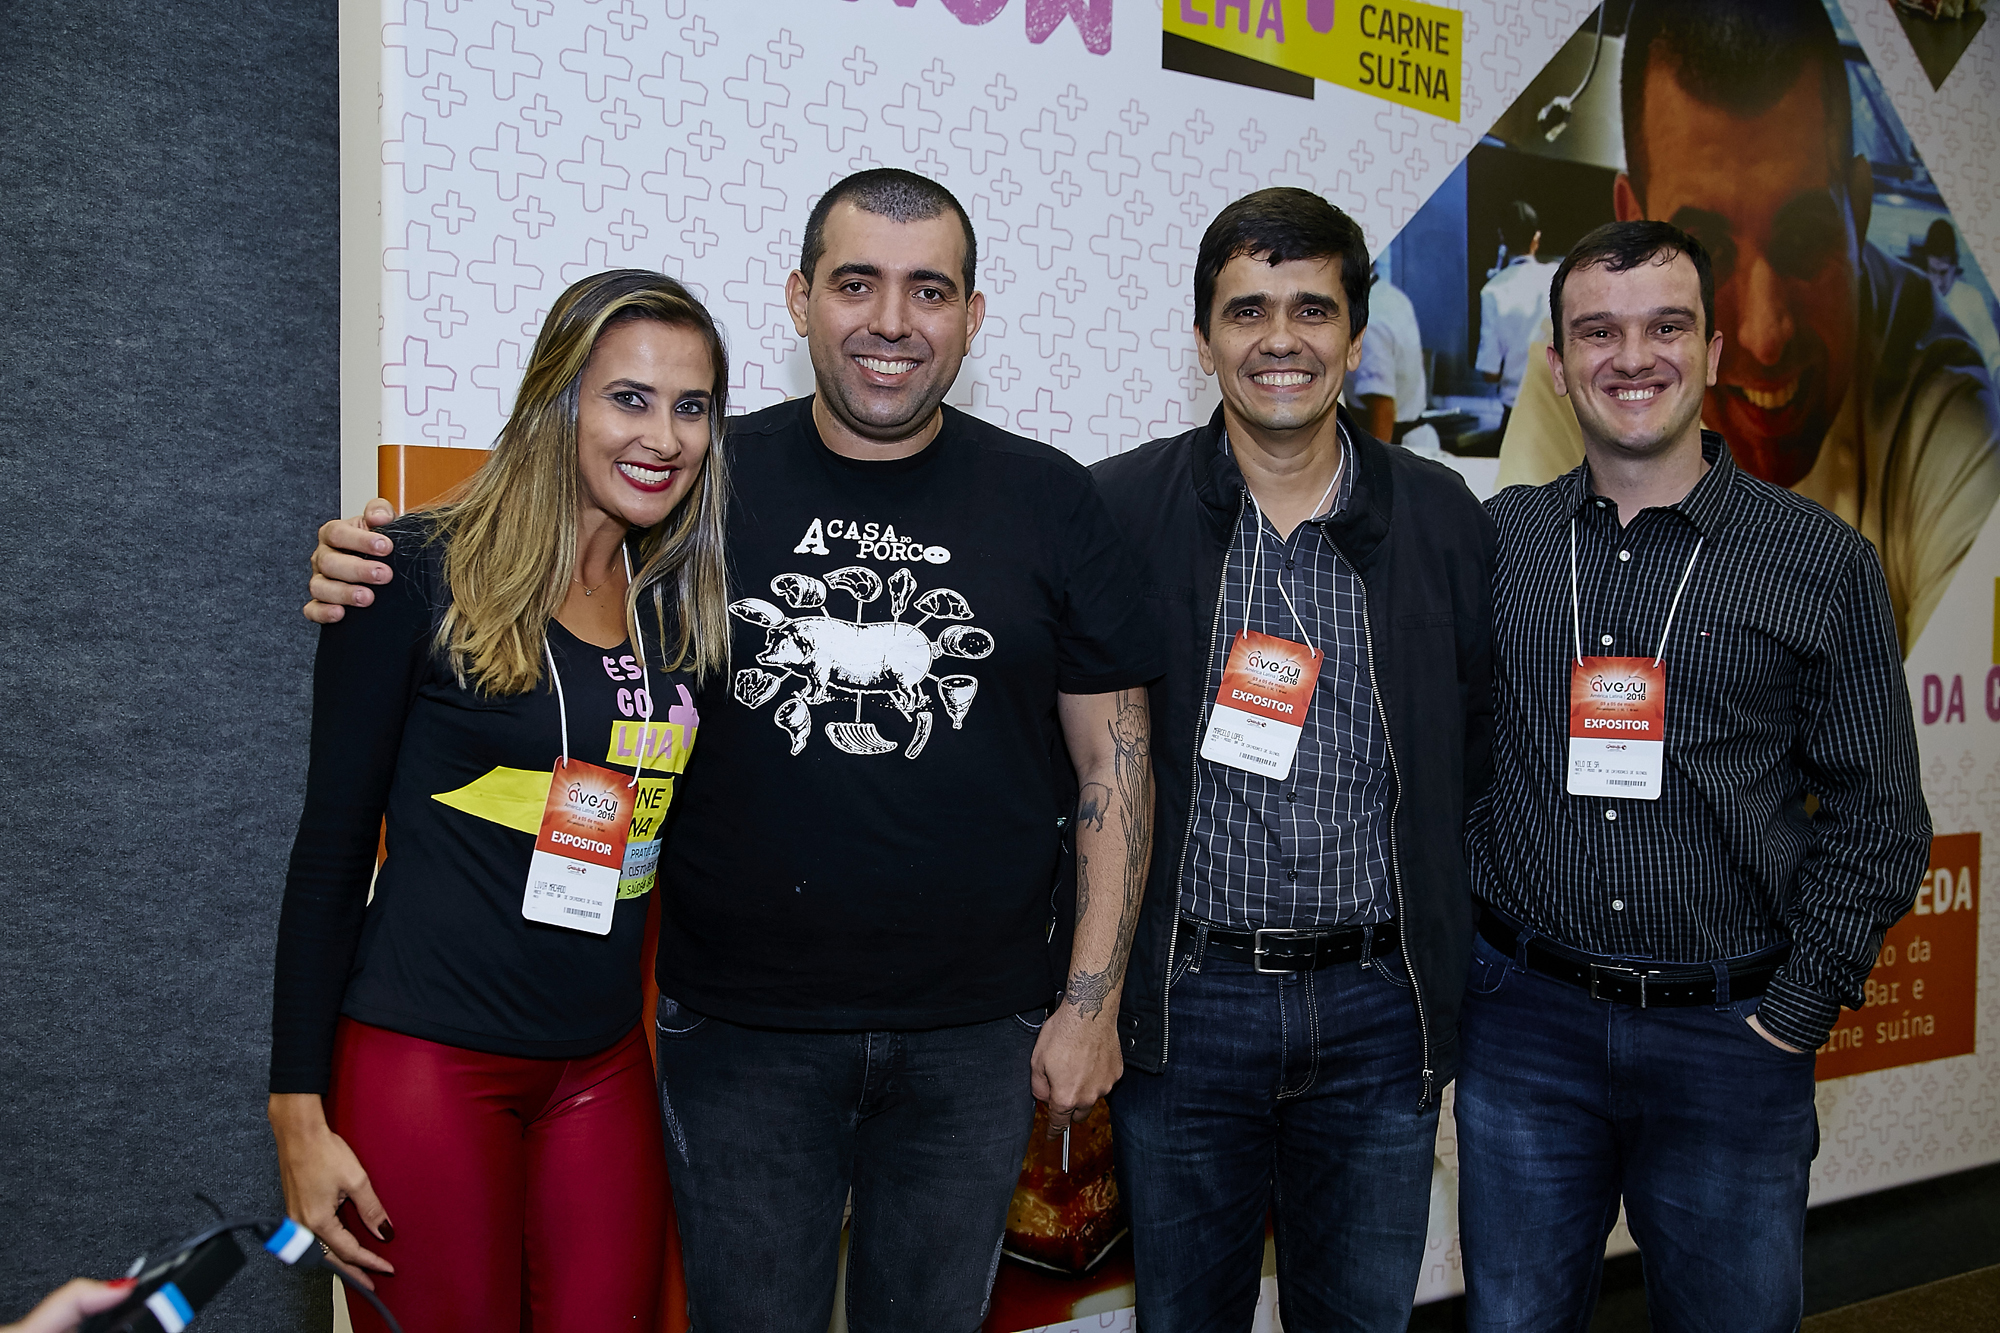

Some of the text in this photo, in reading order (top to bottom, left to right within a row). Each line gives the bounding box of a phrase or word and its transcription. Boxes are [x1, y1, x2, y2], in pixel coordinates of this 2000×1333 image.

[1359, 3, 1450, 56] CARNE
[1358, 50, 1450, 102] SUÍNA
[793, 517, 912, 556] A CASA DO
[856, 540, 951, 564] PORCO
[602, 655, 642, 681] ES
[1278, 675, 1298, 686] 2016
[616, 687, 654, 718] CO
[1231, 689, 1294, 714] EXPOSITOR
[1626, 692, 1646, 701] 2016
[1922, 673, 1966, 726] DA
[1584, 718, 1650, 731] EXPOSITOR
[616, 725, 673, 760] LHA
[597, 809, 615, 821] 2016
[551, 830, 612, 855] EXPOSITOR
[1907, 935, 1931, 964] da
[1864, 978, 1925, 1008] Bar e
[1875, 1009, 1936, 1044] suína
